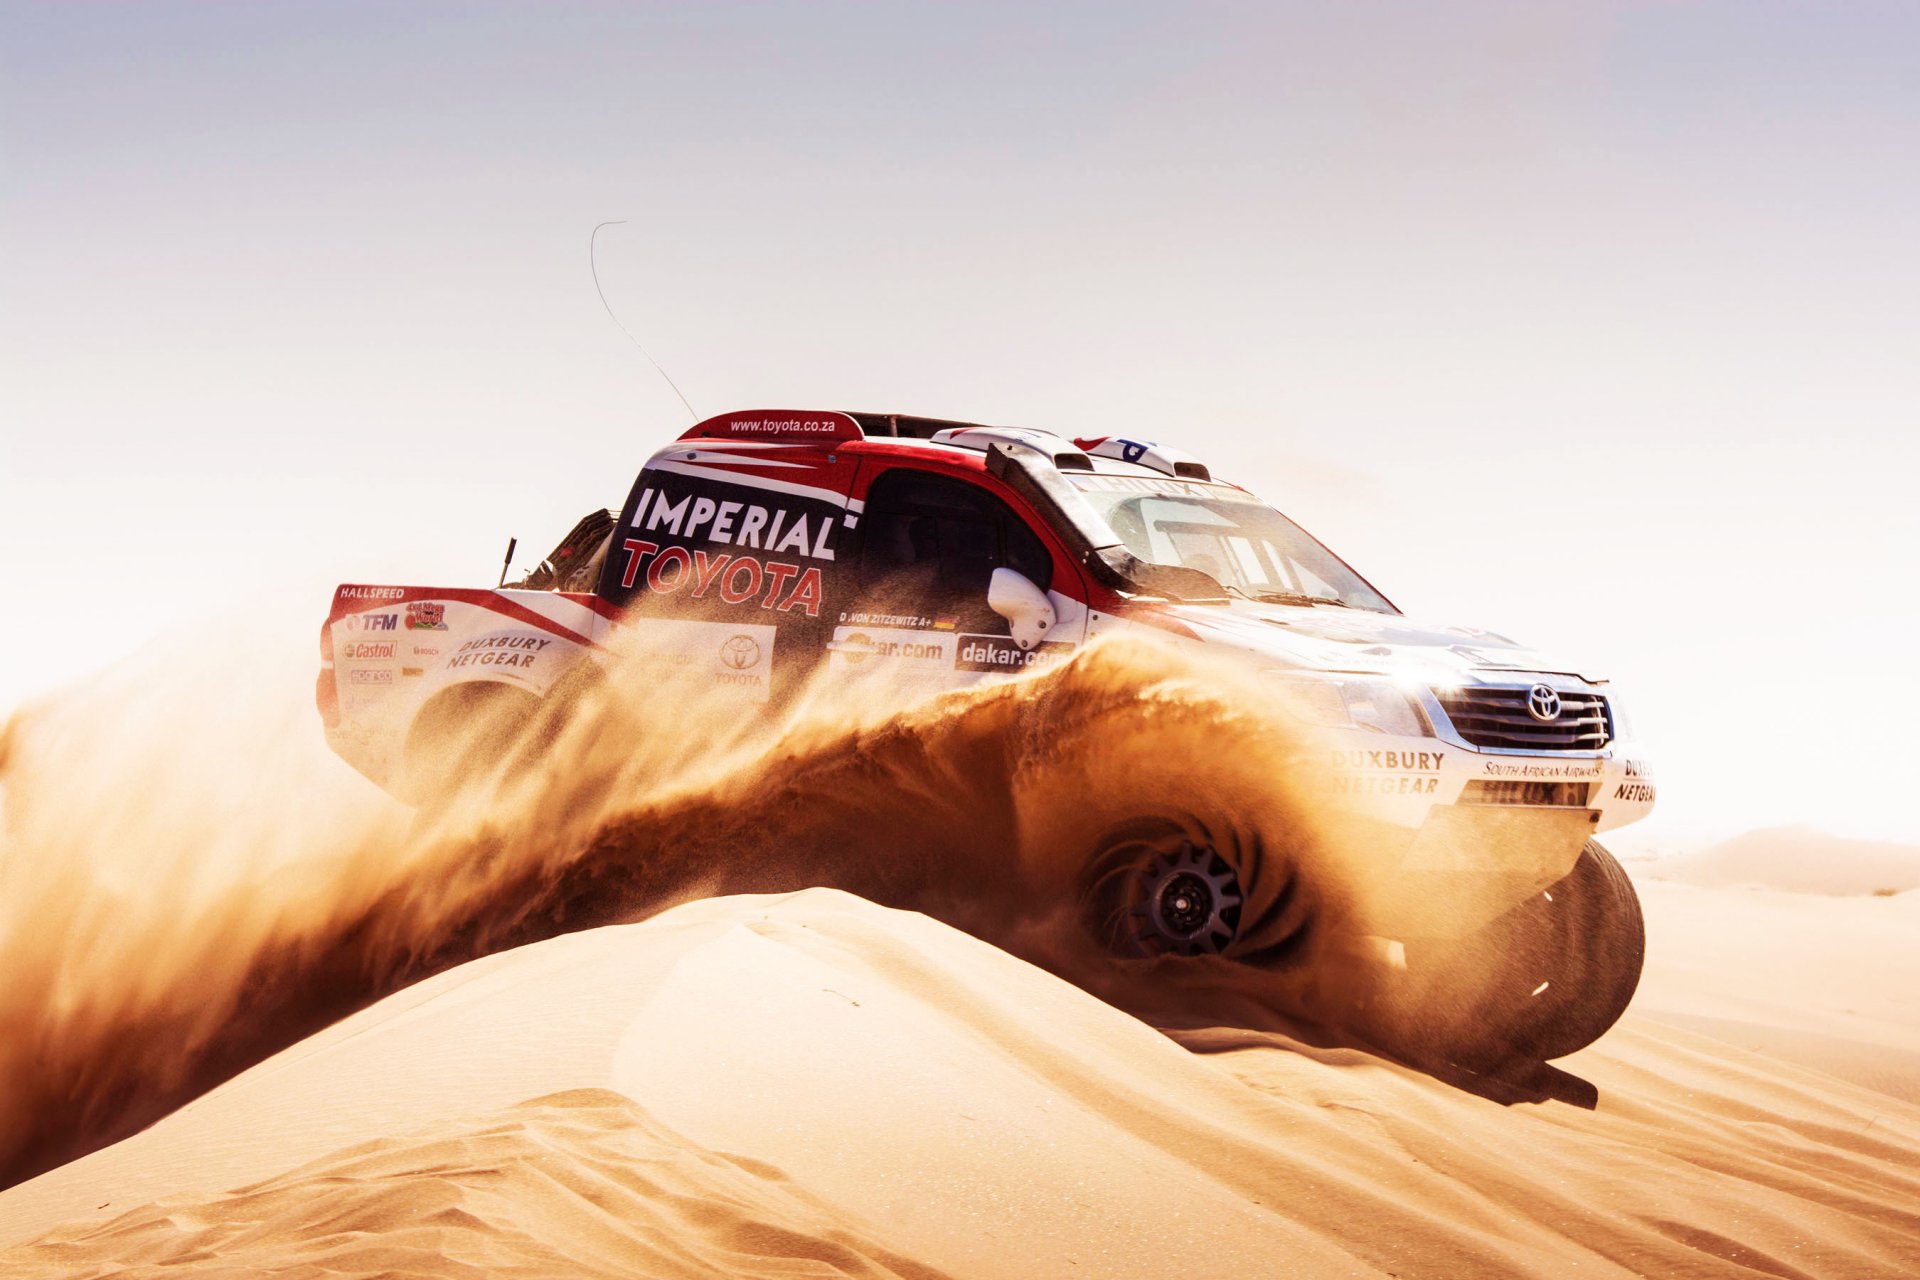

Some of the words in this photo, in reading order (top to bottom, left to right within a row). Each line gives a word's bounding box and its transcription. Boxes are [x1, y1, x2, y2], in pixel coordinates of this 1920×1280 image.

[730, 418, 836, 434] www.toyota.co.za
[630, 488, 836, 561] IMPERIAL
[621, 538, 822, 617] TOYOTA
[340, 587, 405, 599] HALLSPEED
[362, 614, 398, 631] TFM
[355, 643, 395, 658] Castrol
[458, 636, 552, 653] DUXBURY
[446, 651, 536, 670] NETGEAR
[714, 672, 762, 687] TOYOTA
[1483, 761, 1520, 776] SOUTH
[1520, 764, 1563, 778] AFRICAN
